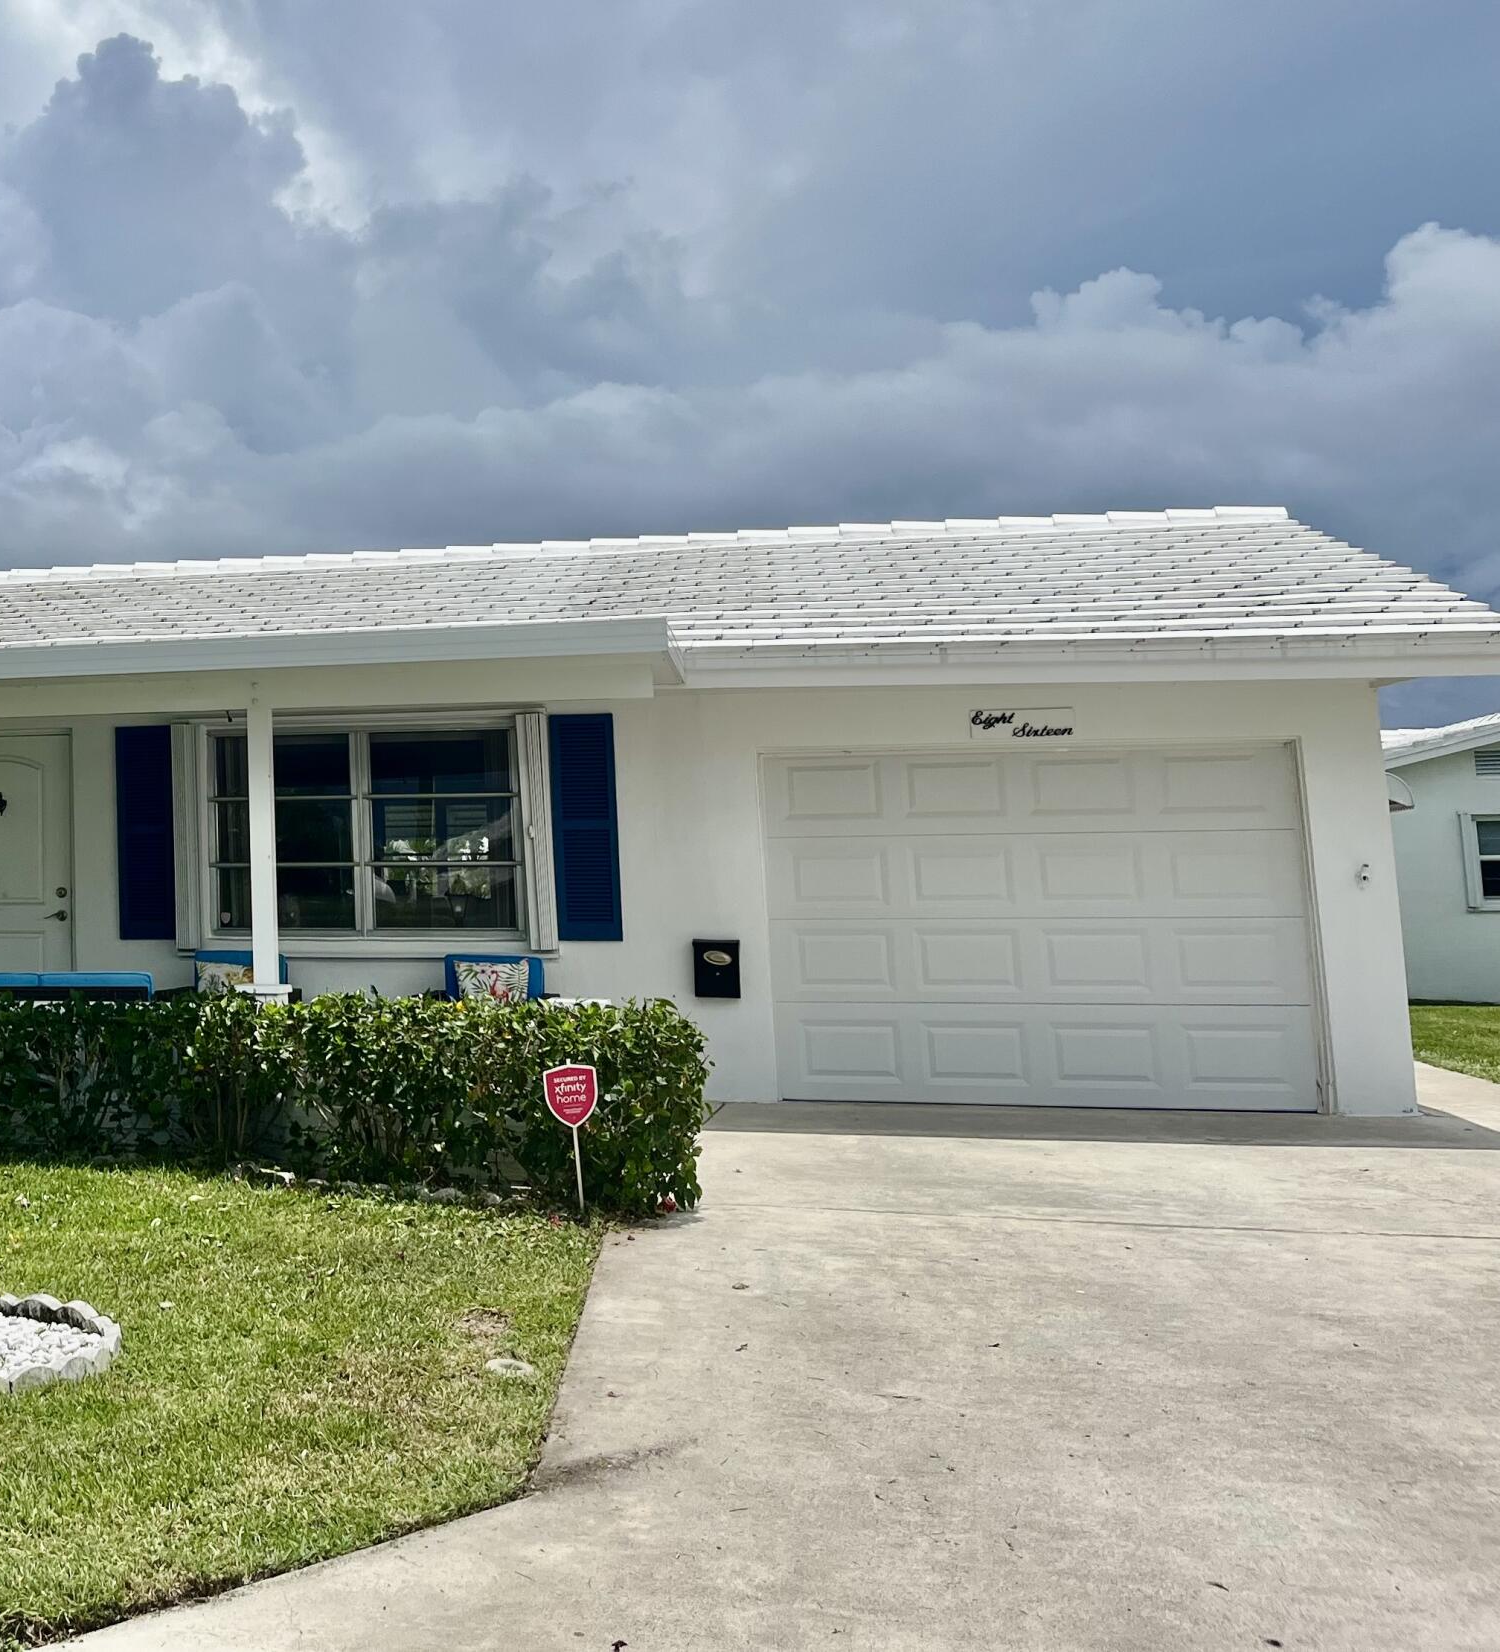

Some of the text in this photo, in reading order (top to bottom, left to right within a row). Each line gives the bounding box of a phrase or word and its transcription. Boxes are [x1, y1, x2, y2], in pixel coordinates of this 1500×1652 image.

[971, 710, 1015, 730] Eight
[1012, 722, 1073, 738] Sixteen
[554, 1082, 587, 1096] xfinity
[556, 1094, 587, 1104] home
